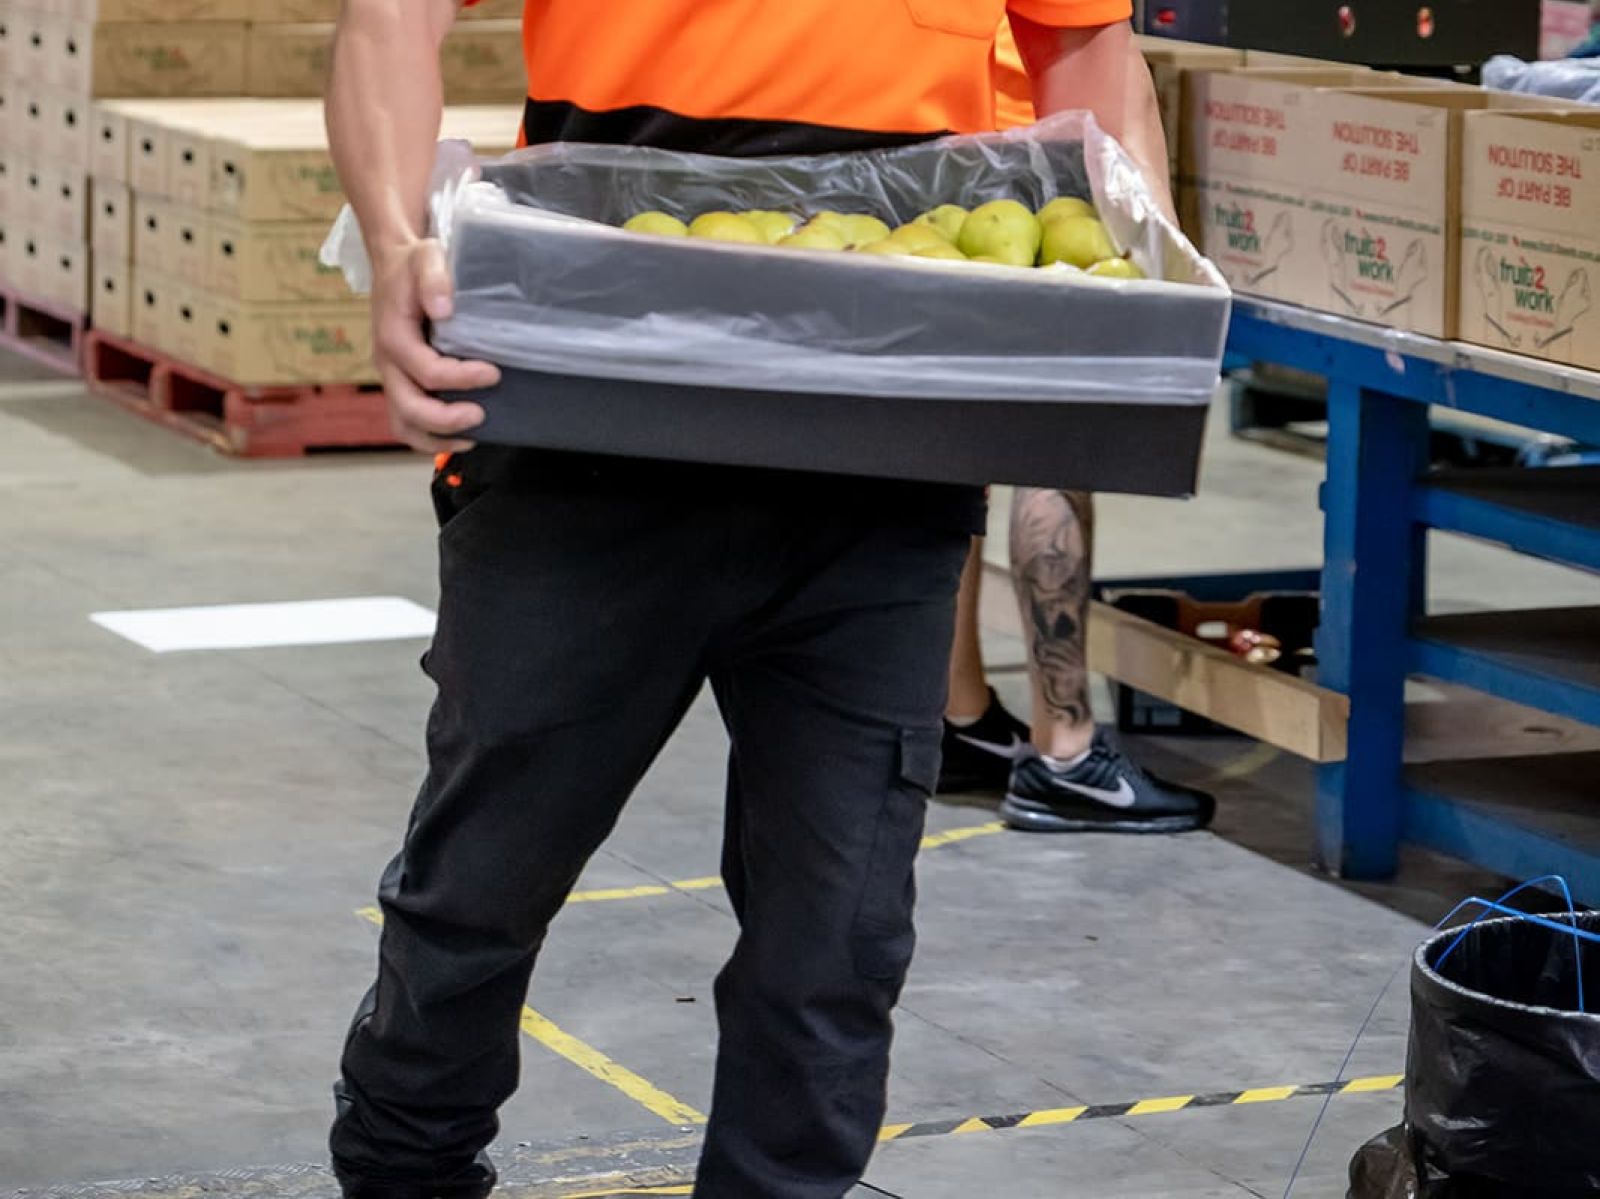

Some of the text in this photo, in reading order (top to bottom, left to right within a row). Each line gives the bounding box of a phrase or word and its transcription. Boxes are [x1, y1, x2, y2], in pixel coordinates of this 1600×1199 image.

[1333, 124, 1418, 155] THE SOLUTION
[1360, 156, 1392, 179] PART
[1394, 161, 1409, 182] BE
[1488, 147, 1582, 179] THE SOLUTION
[1497, 179, 1571, 208] BE PART OF
[1229, 231, 1261, 253] work
[1359, 259, 1394, 282] work
[1515, 287, 1554, 313] work
